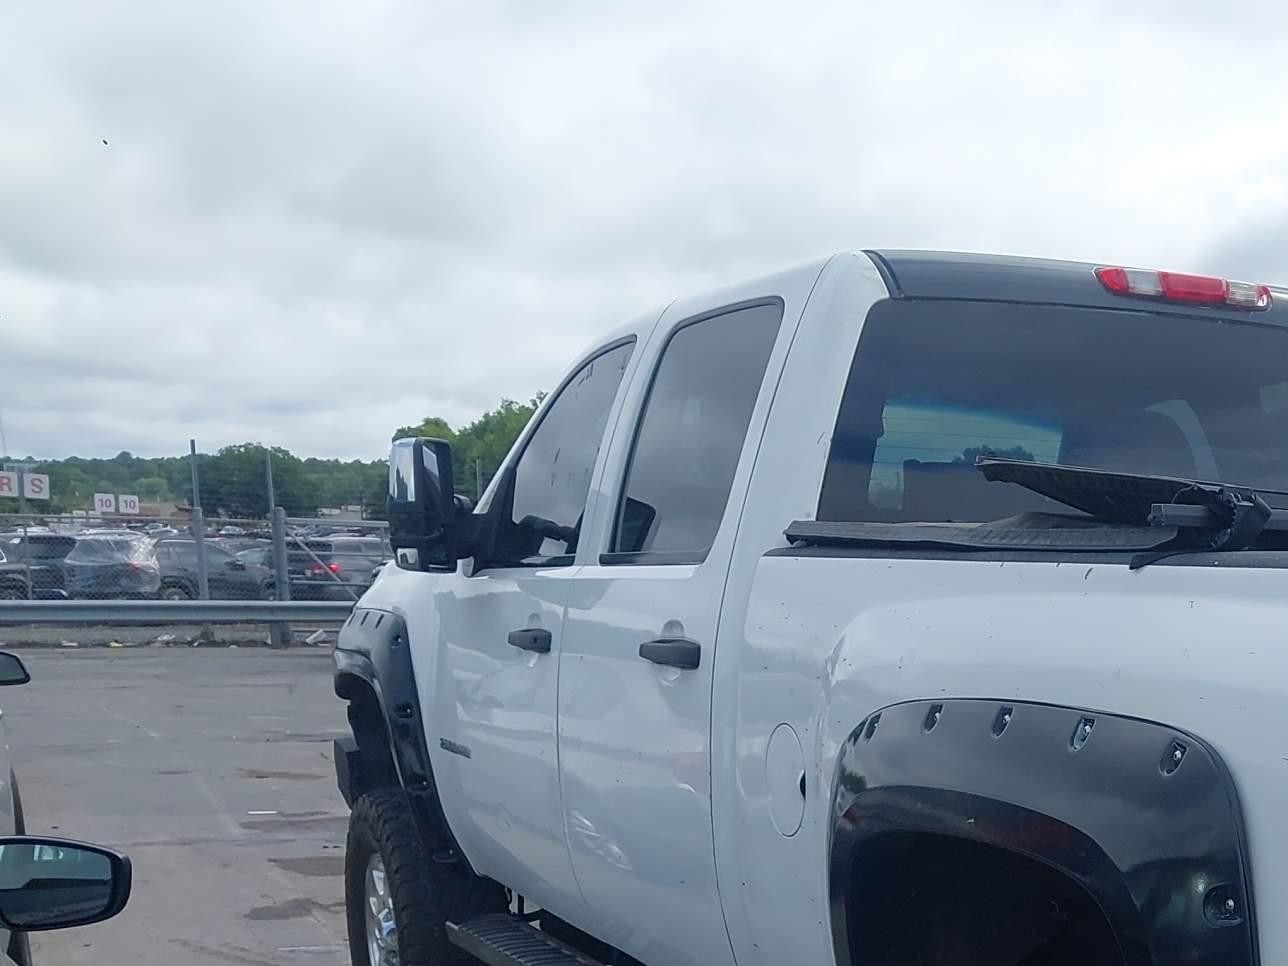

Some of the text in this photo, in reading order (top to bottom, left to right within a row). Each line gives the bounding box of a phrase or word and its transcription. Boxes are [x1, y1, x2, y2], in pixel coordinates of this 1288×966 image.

[30, 477, 44, 494] S
[98, 498, 112, 508] 10
[124, 499, 136, 509] 10
